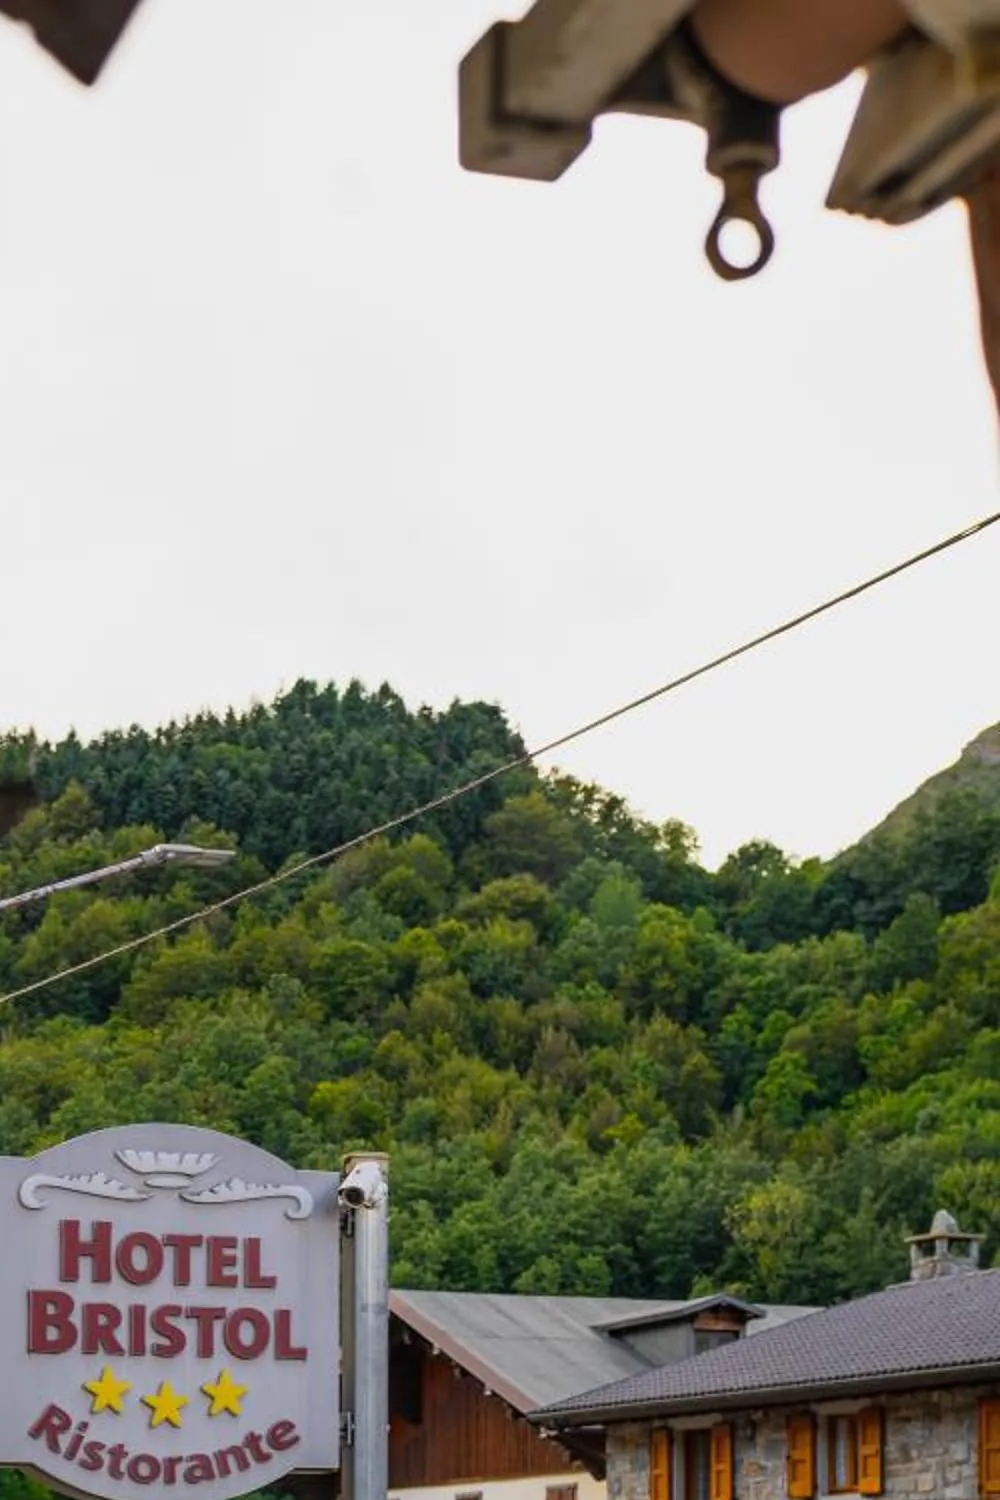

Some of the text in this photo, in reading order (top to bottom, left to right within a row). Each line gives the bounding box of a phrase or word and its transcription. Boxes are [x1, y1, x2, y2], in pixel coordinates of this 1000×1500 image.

[58, 1218, 278, 1289] HOTEL
[26, 1289, 309, 1361] BRISTOL
[28, 1402, 301, 1486] Ristorante
